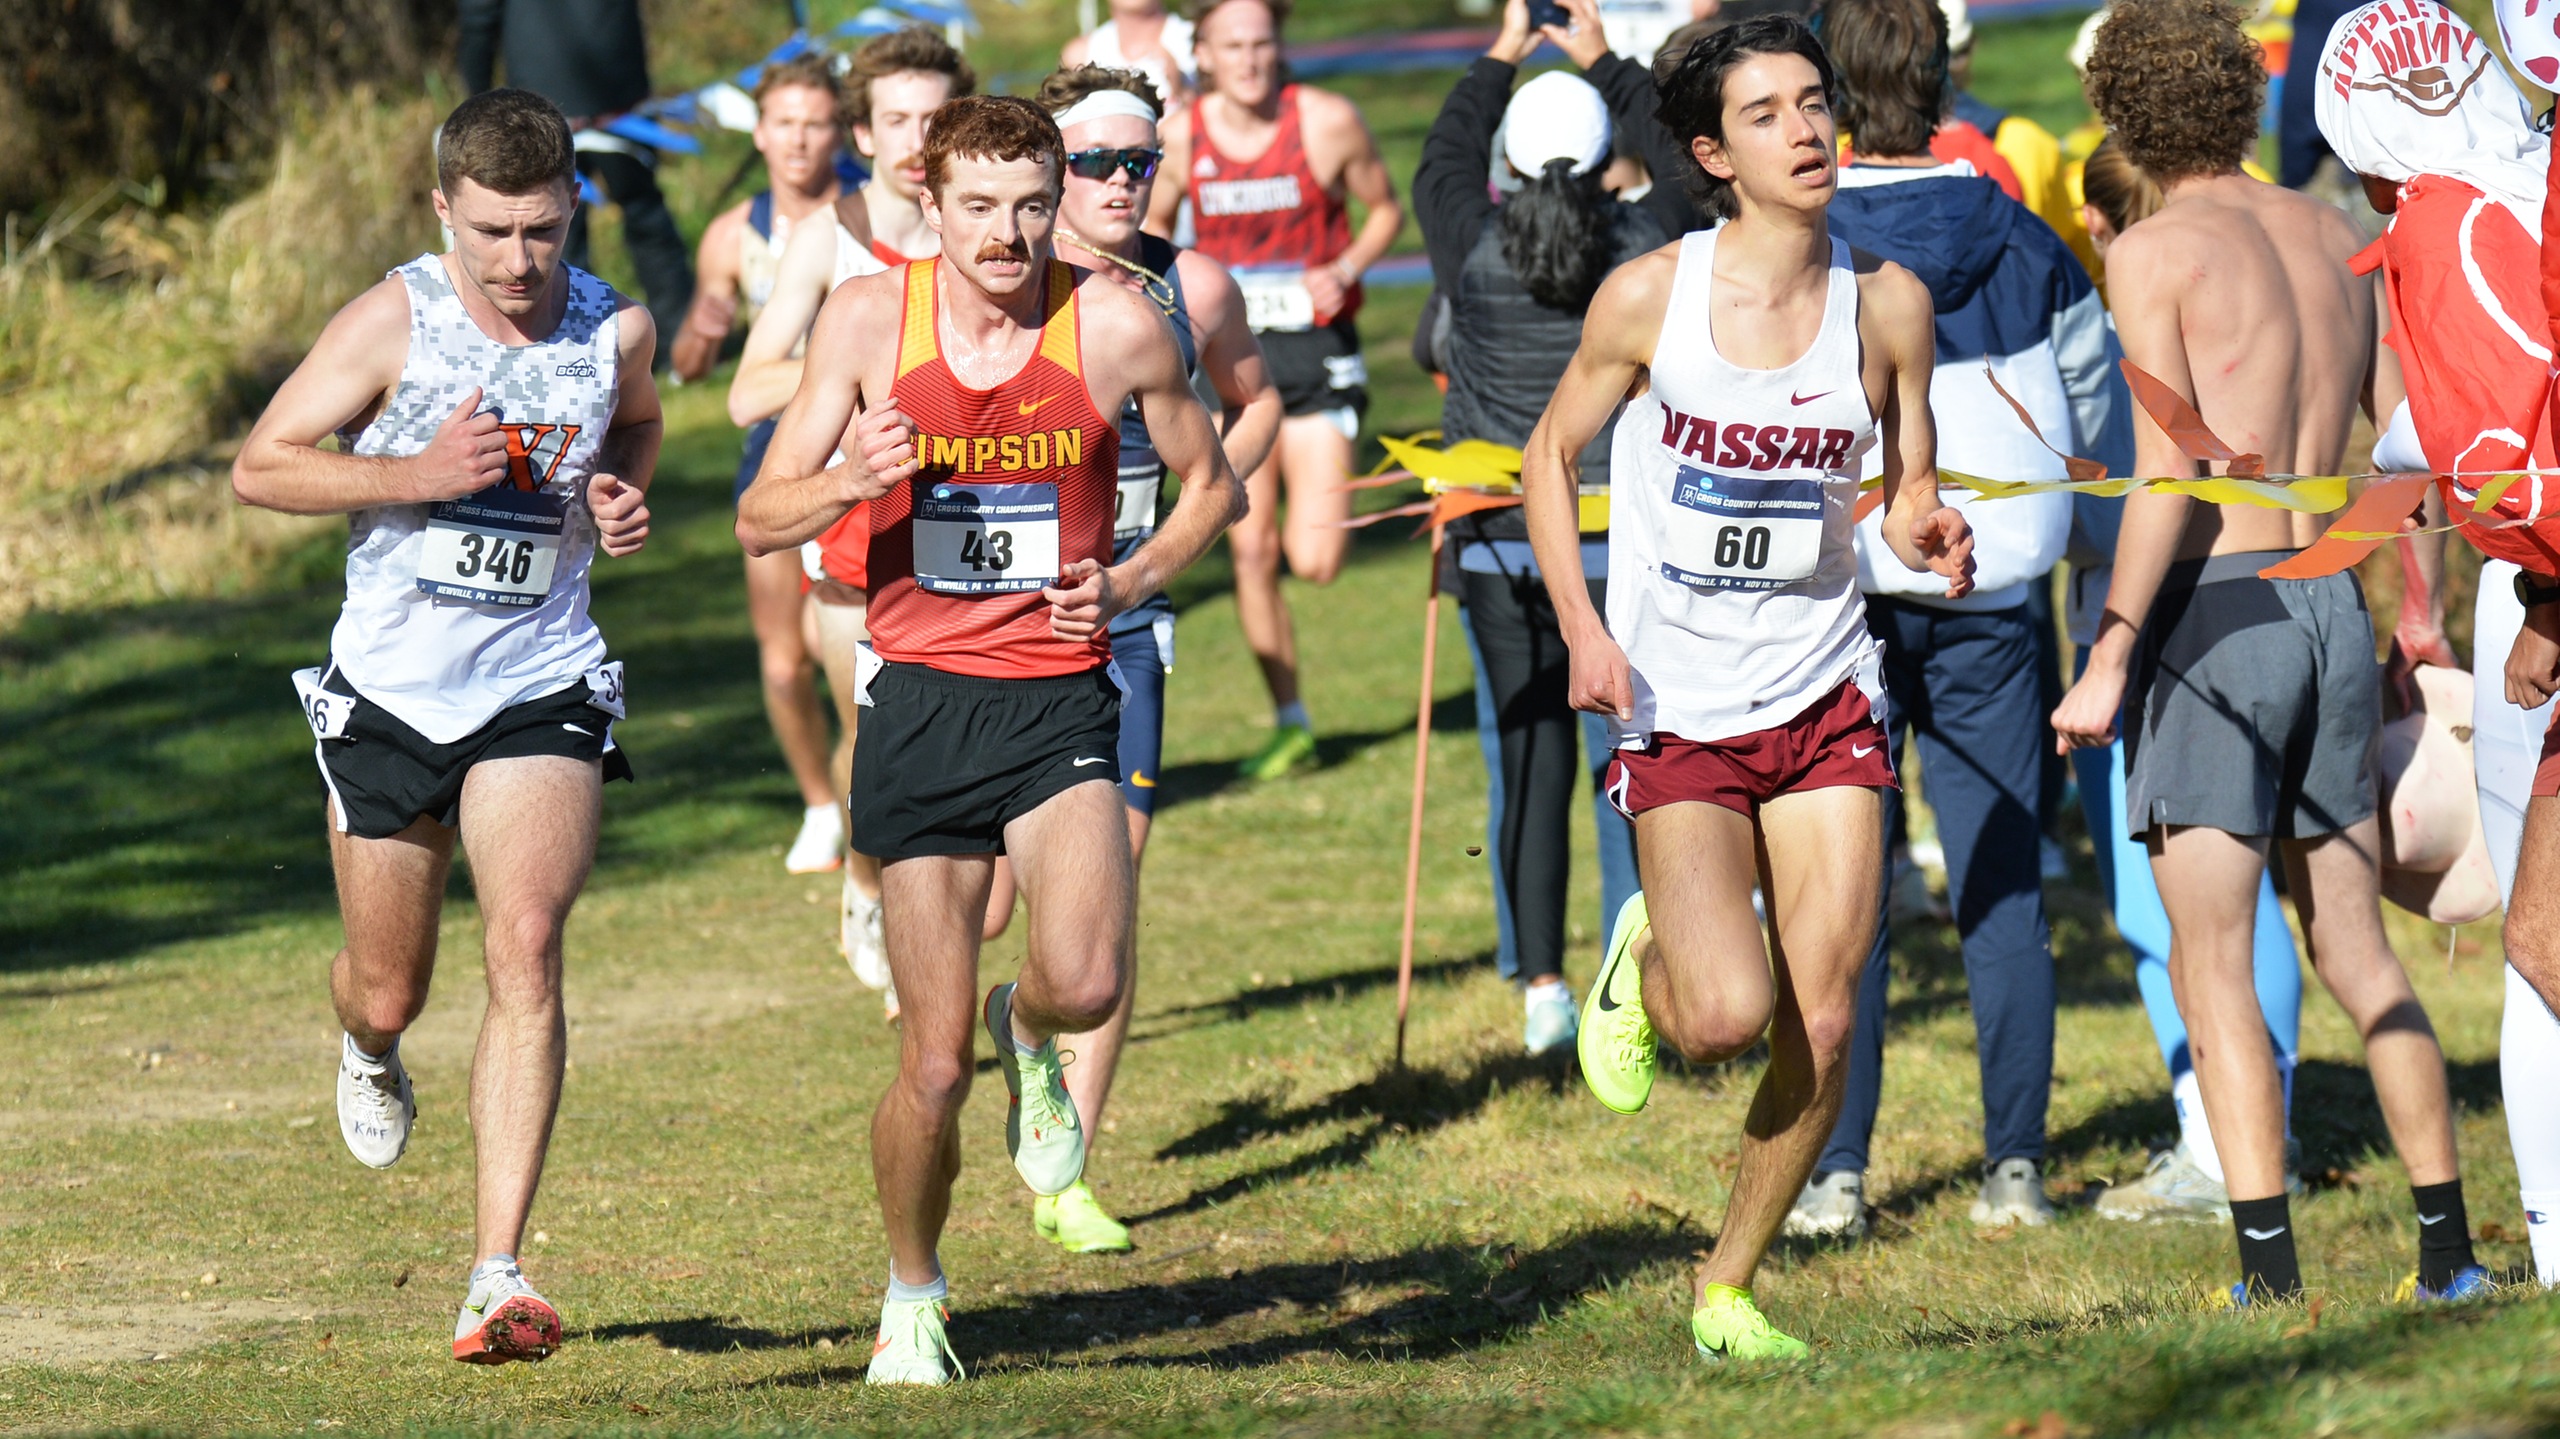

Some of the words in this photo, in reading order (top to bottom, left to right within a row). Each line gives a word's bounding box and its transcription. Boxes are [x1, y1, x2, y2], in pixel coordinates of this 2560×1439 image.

[2372, 21, 2477, 77] ARMY
[898, 428, 1082, 474] IMPSON
[1660, 400, 1855, 472] VASSAR
[456, 504, 481, 516] CROSS
[481, 507, 514, 520] COUNTRY
[514, 512, 562, 526] CHAMPIONSHIPS
[937, 504, 961, 513] CROSS
[962, 504, 995, 514] COUNTRY
[995, 503, 1055, 514] CHAMPIONSHIPS
[1696, 492, 1722, 507] CROSS
[1722, 498, 1759, 510] COUNTRY
[1758, 501, 1821, 511] CHAMPIONSHIPS
[456, 533, 534, 584] 346
[960, 530, 1013, 572] 43
[1714, 526, 1771, 571] 60
[436, 585, 473, 600] NEWVILLE,
[475, 591, 486, 601] PA
[498, 595, 510, 603] NOV
[933, 580, 969, 591] NEWVILLE,
[971, 581, 982, 590] PA
[994, 581, 1010, 590] NOV
[1021, 580, 1041, 590] 2023
[1679, 573, 1716, 588] NEWVILLE,
[1719, 578, 1731, 587] PA
[1744, 580, 1761, 588] NOV
